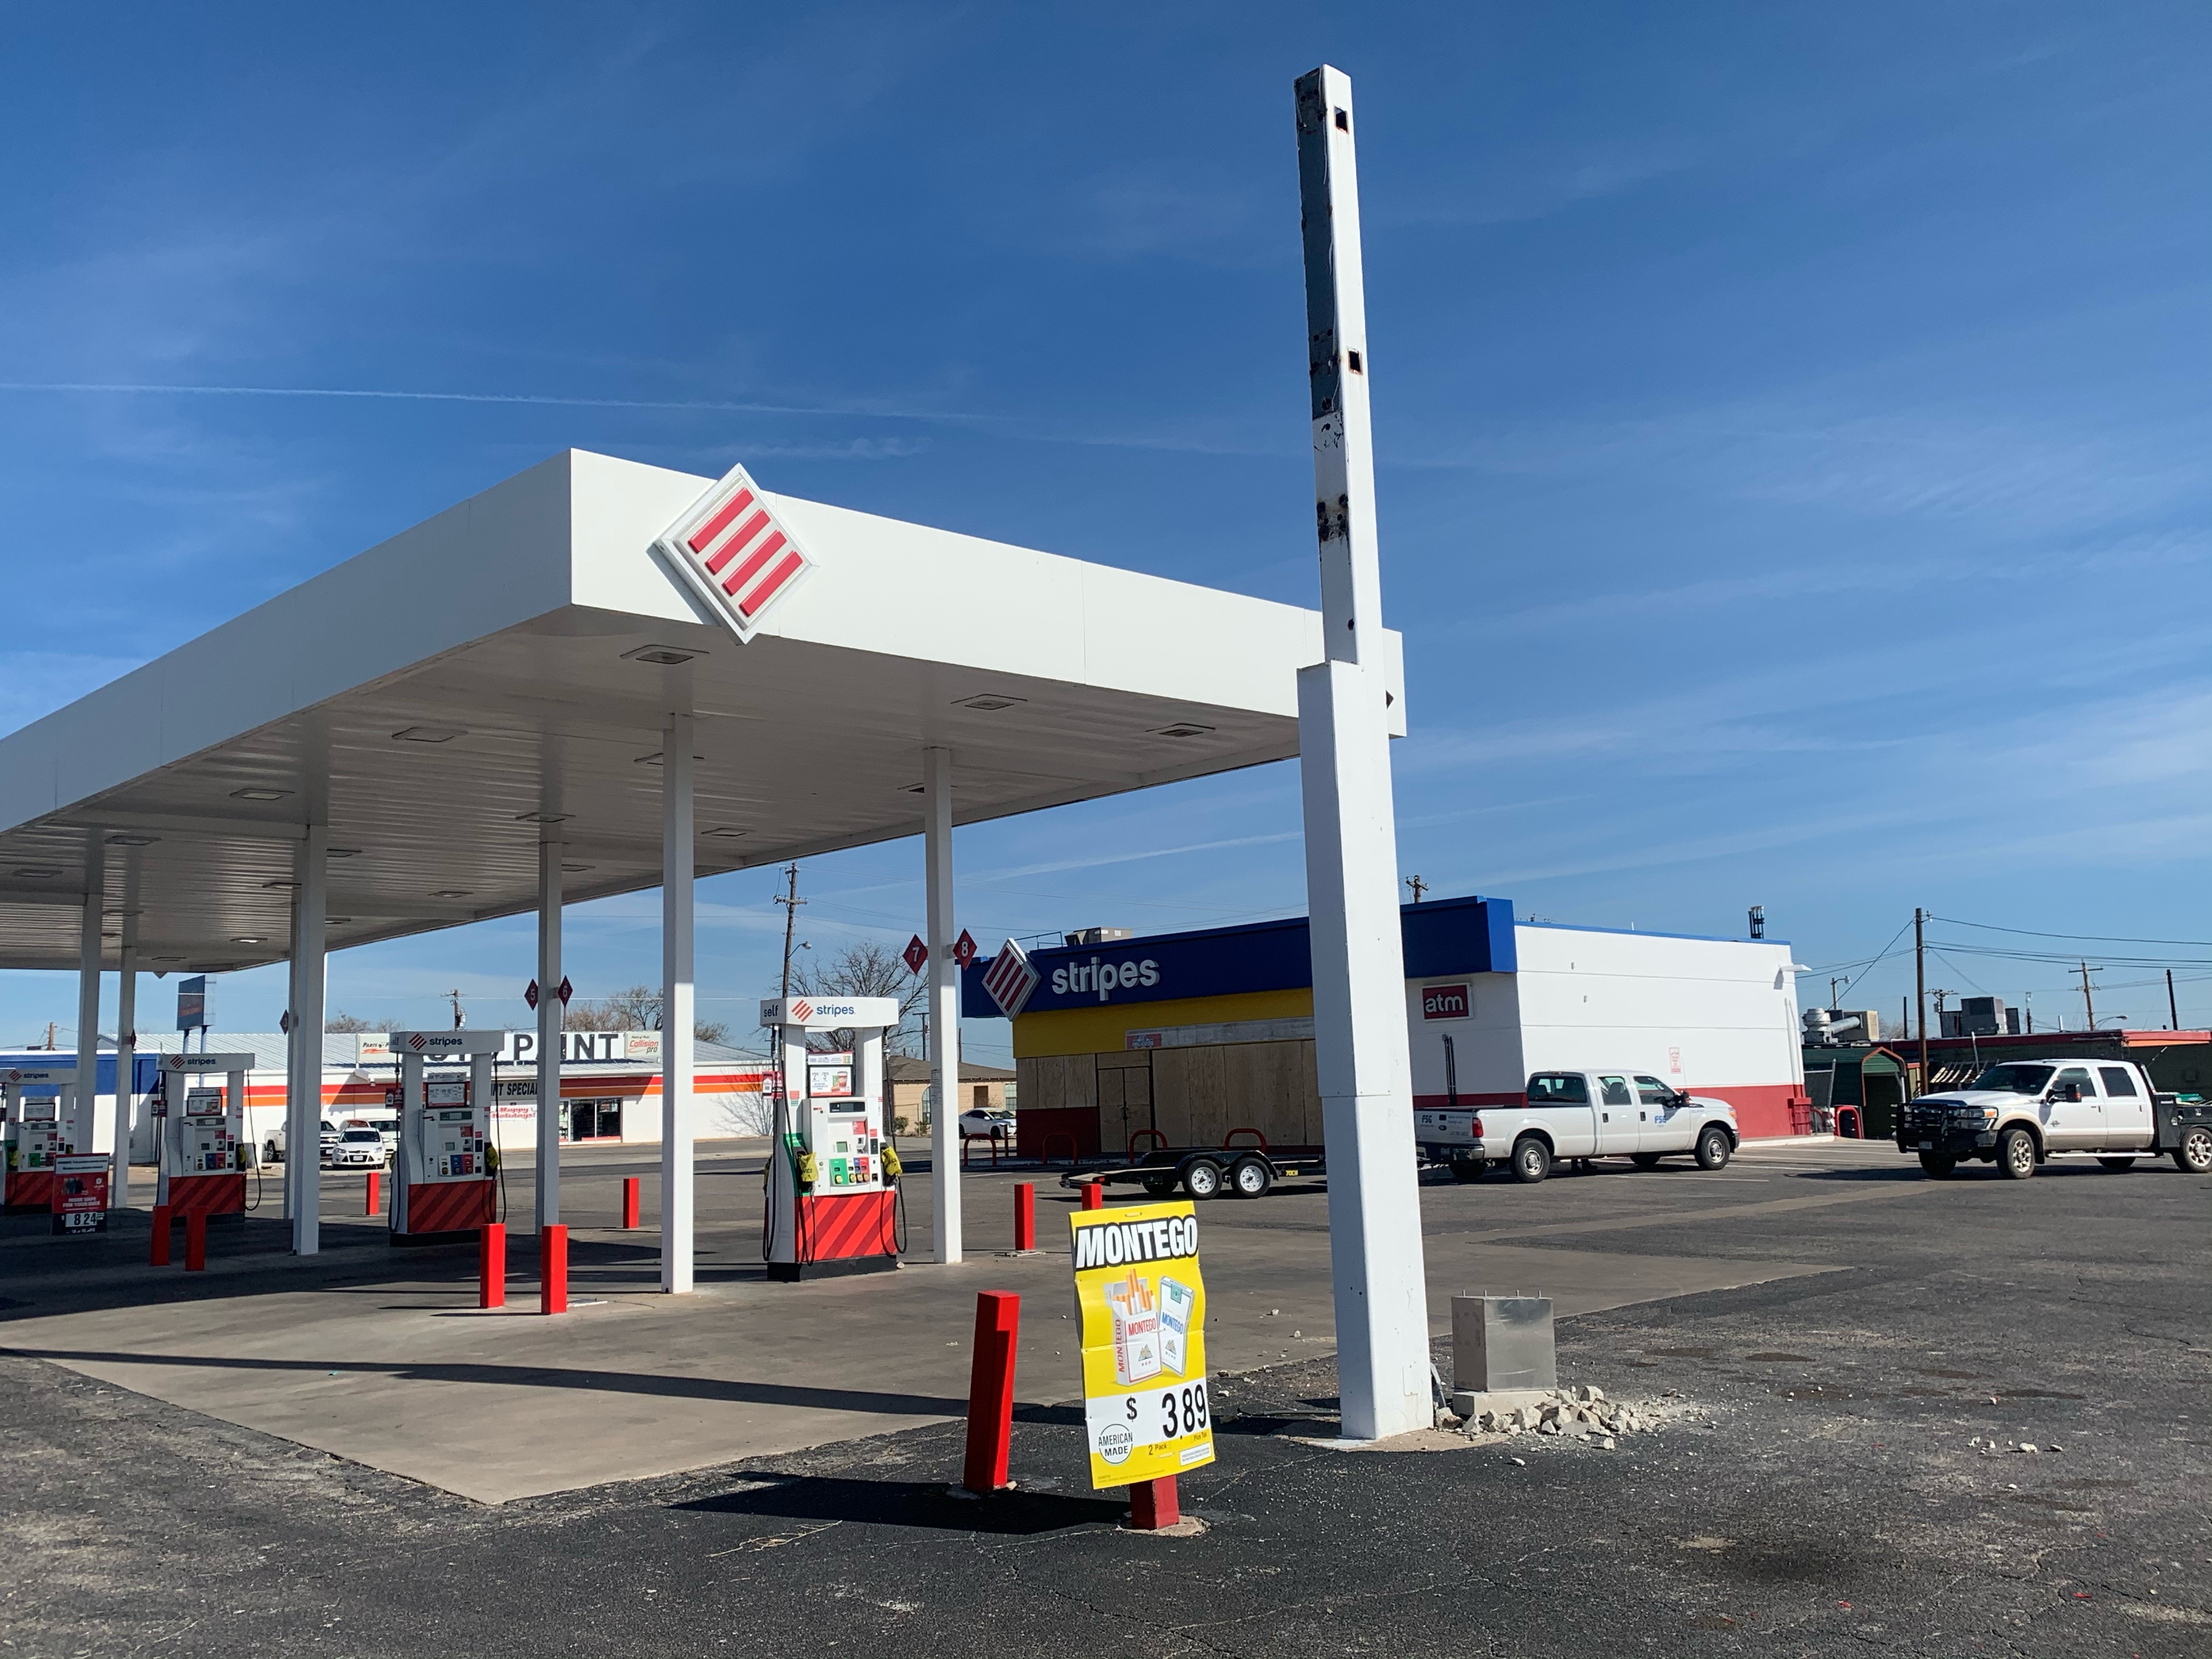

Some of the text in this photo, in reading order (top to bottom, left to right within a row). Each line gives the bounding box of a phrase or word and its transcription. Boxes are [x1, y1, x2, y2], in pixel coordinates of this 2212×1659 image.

[912, 946, 920, 962] 7
[961, 941, 968, 957] 8
[1052, 957, 1160, 1001] stripes
[530, 988, 535, 1001] 5
[563, 985, 567, 998] 6
[816, 1004, 854, 1017] stripes
[1425, 994, 1463, 1013] atm
[764, 1005, 778, 1018] self
[429, 1036, 462, 1047] stripes
[514, 1032, 618, 1060] PINT
[187, 1058, 216, 1066] stripes
[1076, 1217, 1198, 1269] MONTEGO
[1128, 1318, 1156, 1336] MONTEGO
[1161, 1312, 1183, 1335] MONTEGO
[1115, 1319, 1125, 1373] MONTEGO
[1165, 1351, 1176, 1360] BLUE
[1126, 1395, 1137, 1423] $
[1098, 1432, 1133, 1447] AMERICAN
[1104, 1446, 1128, 1457] MADE
[1148, 1443, 1167, 1455] 2 Pack
